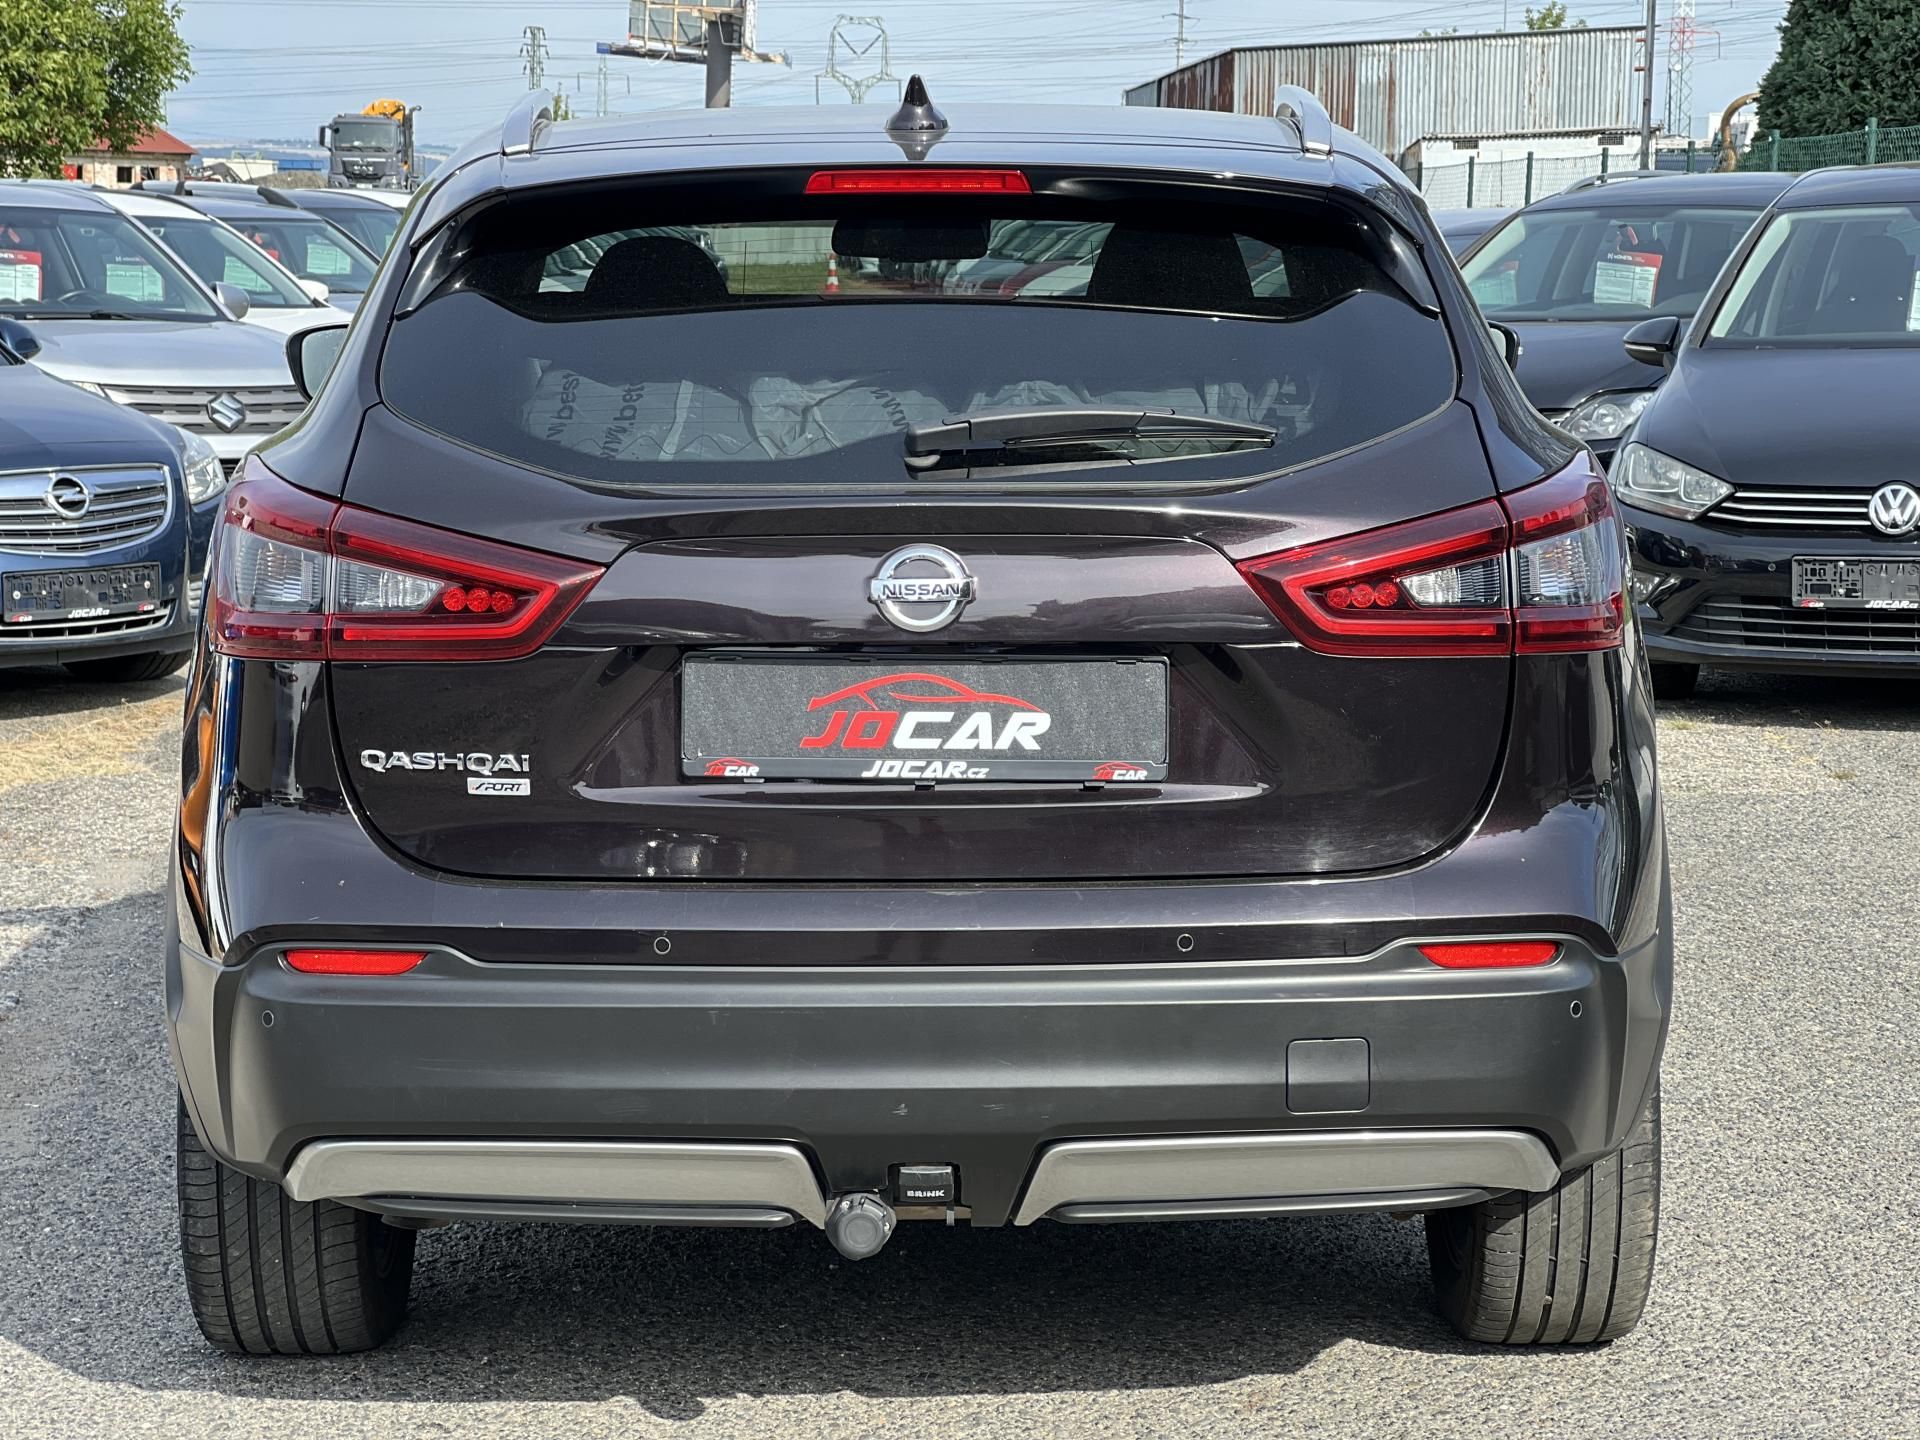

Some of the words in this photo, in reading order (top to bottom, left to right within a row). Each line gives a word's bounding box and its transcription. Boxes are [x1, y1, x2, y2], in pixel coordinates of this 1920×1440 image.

[881, 583, 960, 596] NISSAN
[799, 710, 1051, 750] JOCAR
[360, 749, 530, 776] QASHQAI
[861, 760, 990, 778] JOCAR.cz
[472, 782, 523, 792] SPORT
[906, 1189, 945, 1198] BRINK
